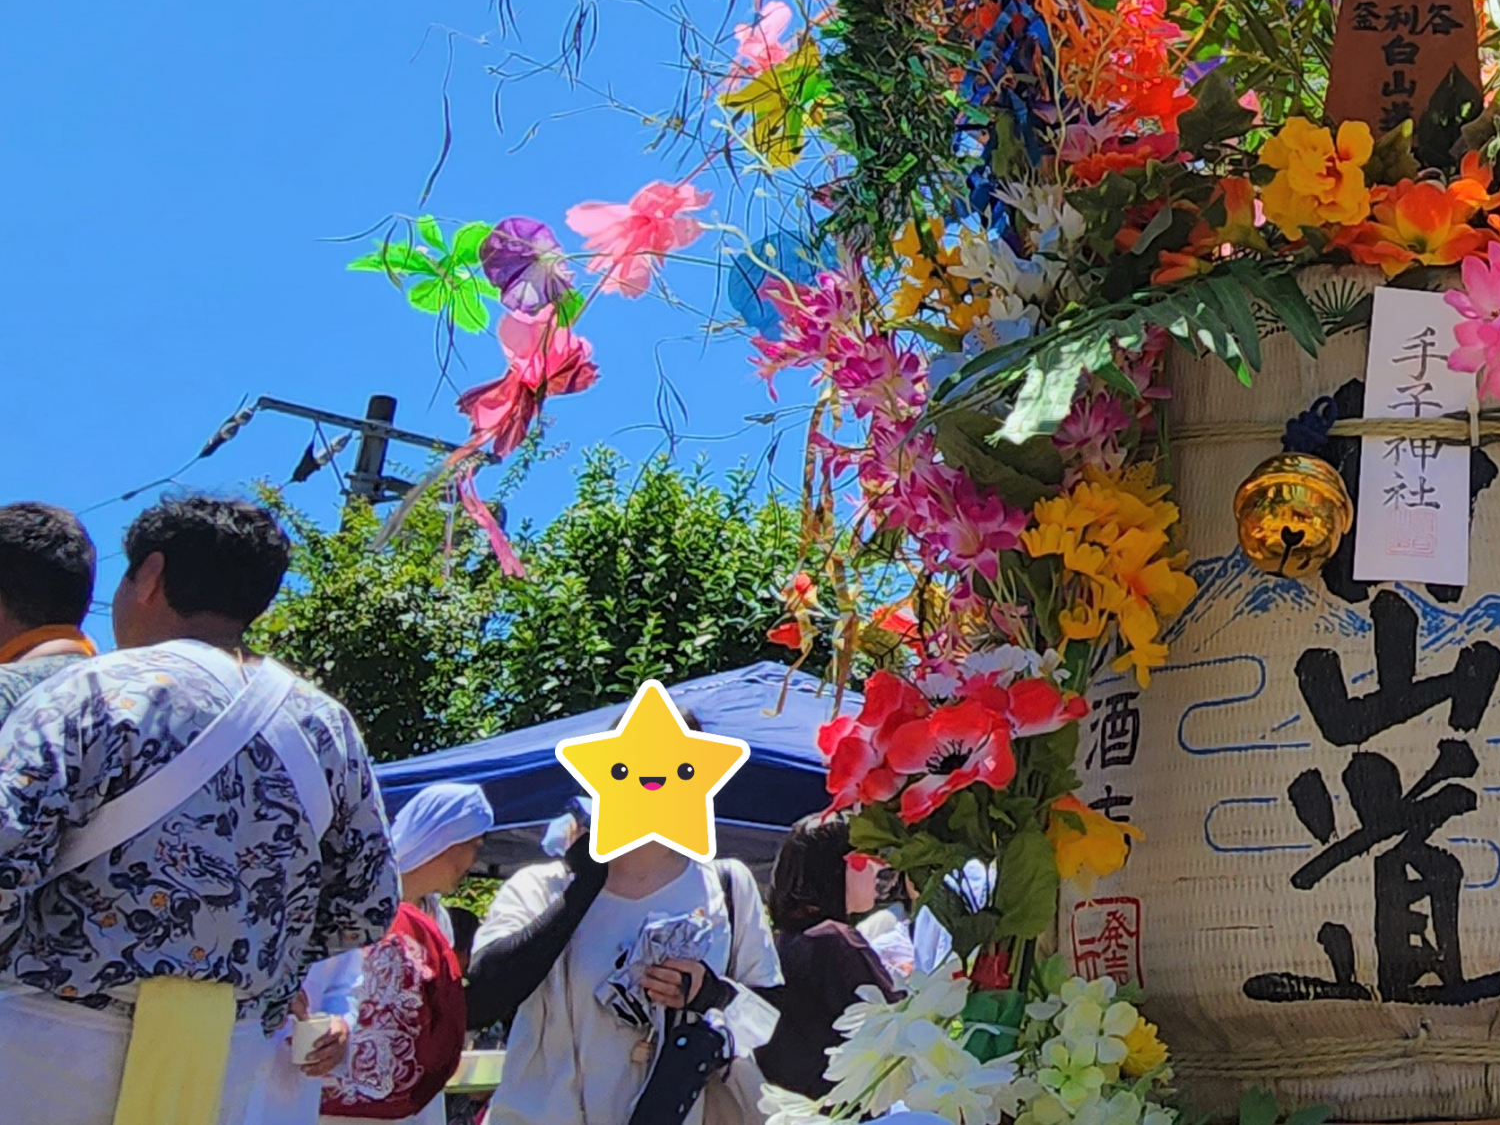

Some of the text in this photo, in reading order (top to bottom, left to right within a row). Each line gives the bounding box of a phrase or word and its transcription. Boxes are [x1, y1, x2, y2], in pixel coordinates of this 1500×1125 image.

[1353, 0, 1464, 35] 釜利谷
[1382, 326, 1448, 511] 手子神社
